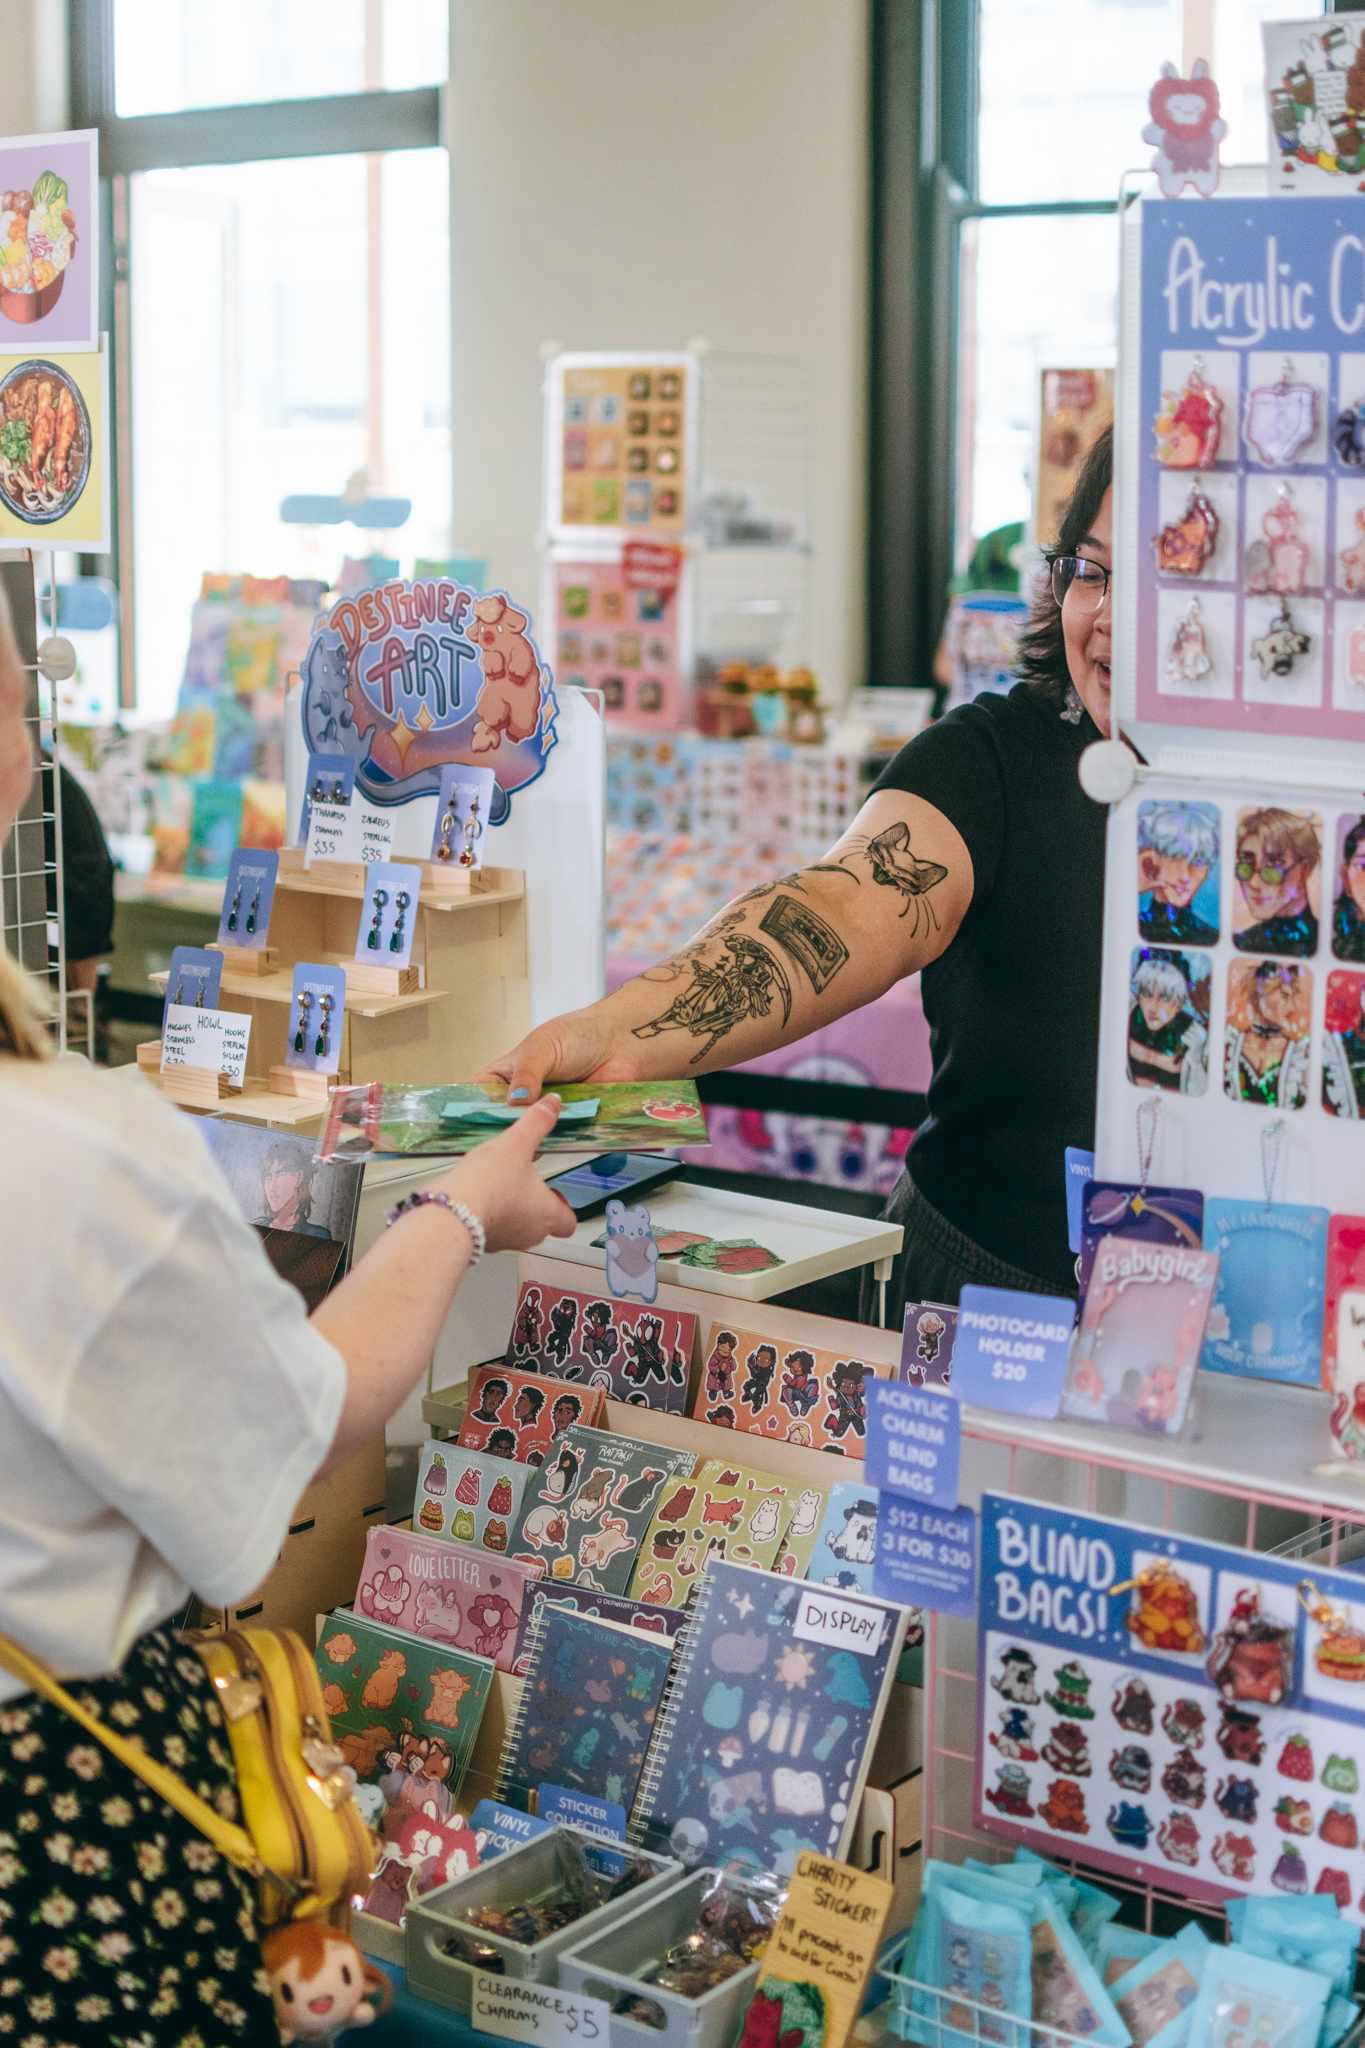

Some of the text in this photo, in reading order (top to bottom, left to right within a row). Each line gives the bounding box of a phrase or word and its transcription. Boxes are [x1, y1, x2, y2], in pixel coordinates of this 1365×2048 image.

[1162, 236, 1314, 346] Acrylic
[330, 584, 471, 661] DESTINEE
[366, 633, 475, 717] ART
[313, 840, 336, 856] $35
[361, 845, 382, 863] $35
[197, 1015, 223, 1031] HOWL
[961, 1311, 1070, 1343] PHOTOCARD
[978, 1337, 1046, 1363] HOLDER
[991, 1361, 1027, 1382] $20
[876, 1388, 949, 1423] ACRYLIC
[881, 1413, 945, 1444] CHARM
[887, 1440, 938, 1469] BLIND
[887, 1466, 934, 1495] BAGS
[888, 1506, 969, 1544] $12 EACH
[881, 1531, 895, 1551] 3
[898, 1535, 934, 1560] FOR
[938, 1544, 972, 1570] $30
[995, 1517, 1115, 1590] BLIND
[408, 1552, 481, 1589] LOVE LETTER
[805, 1605, 876, 1641] DISPLAY
[994, 1571, 1108, 1643] BAGS!
[493, 1811, 531, 1836] VINYL
[545, 1811, 620, 1841] COLLECTION
[559, 1796, 608, 1822] STICKER
[797, 1856, 856, 1891] CHARITY
[813, 1887, 878, 1924] STICKER!
[478, 1978, 565, 2014] CLEARANCE
[476, 2001, 539, 2029] CHARMS
[565, 2003, 599, 2039] $5
